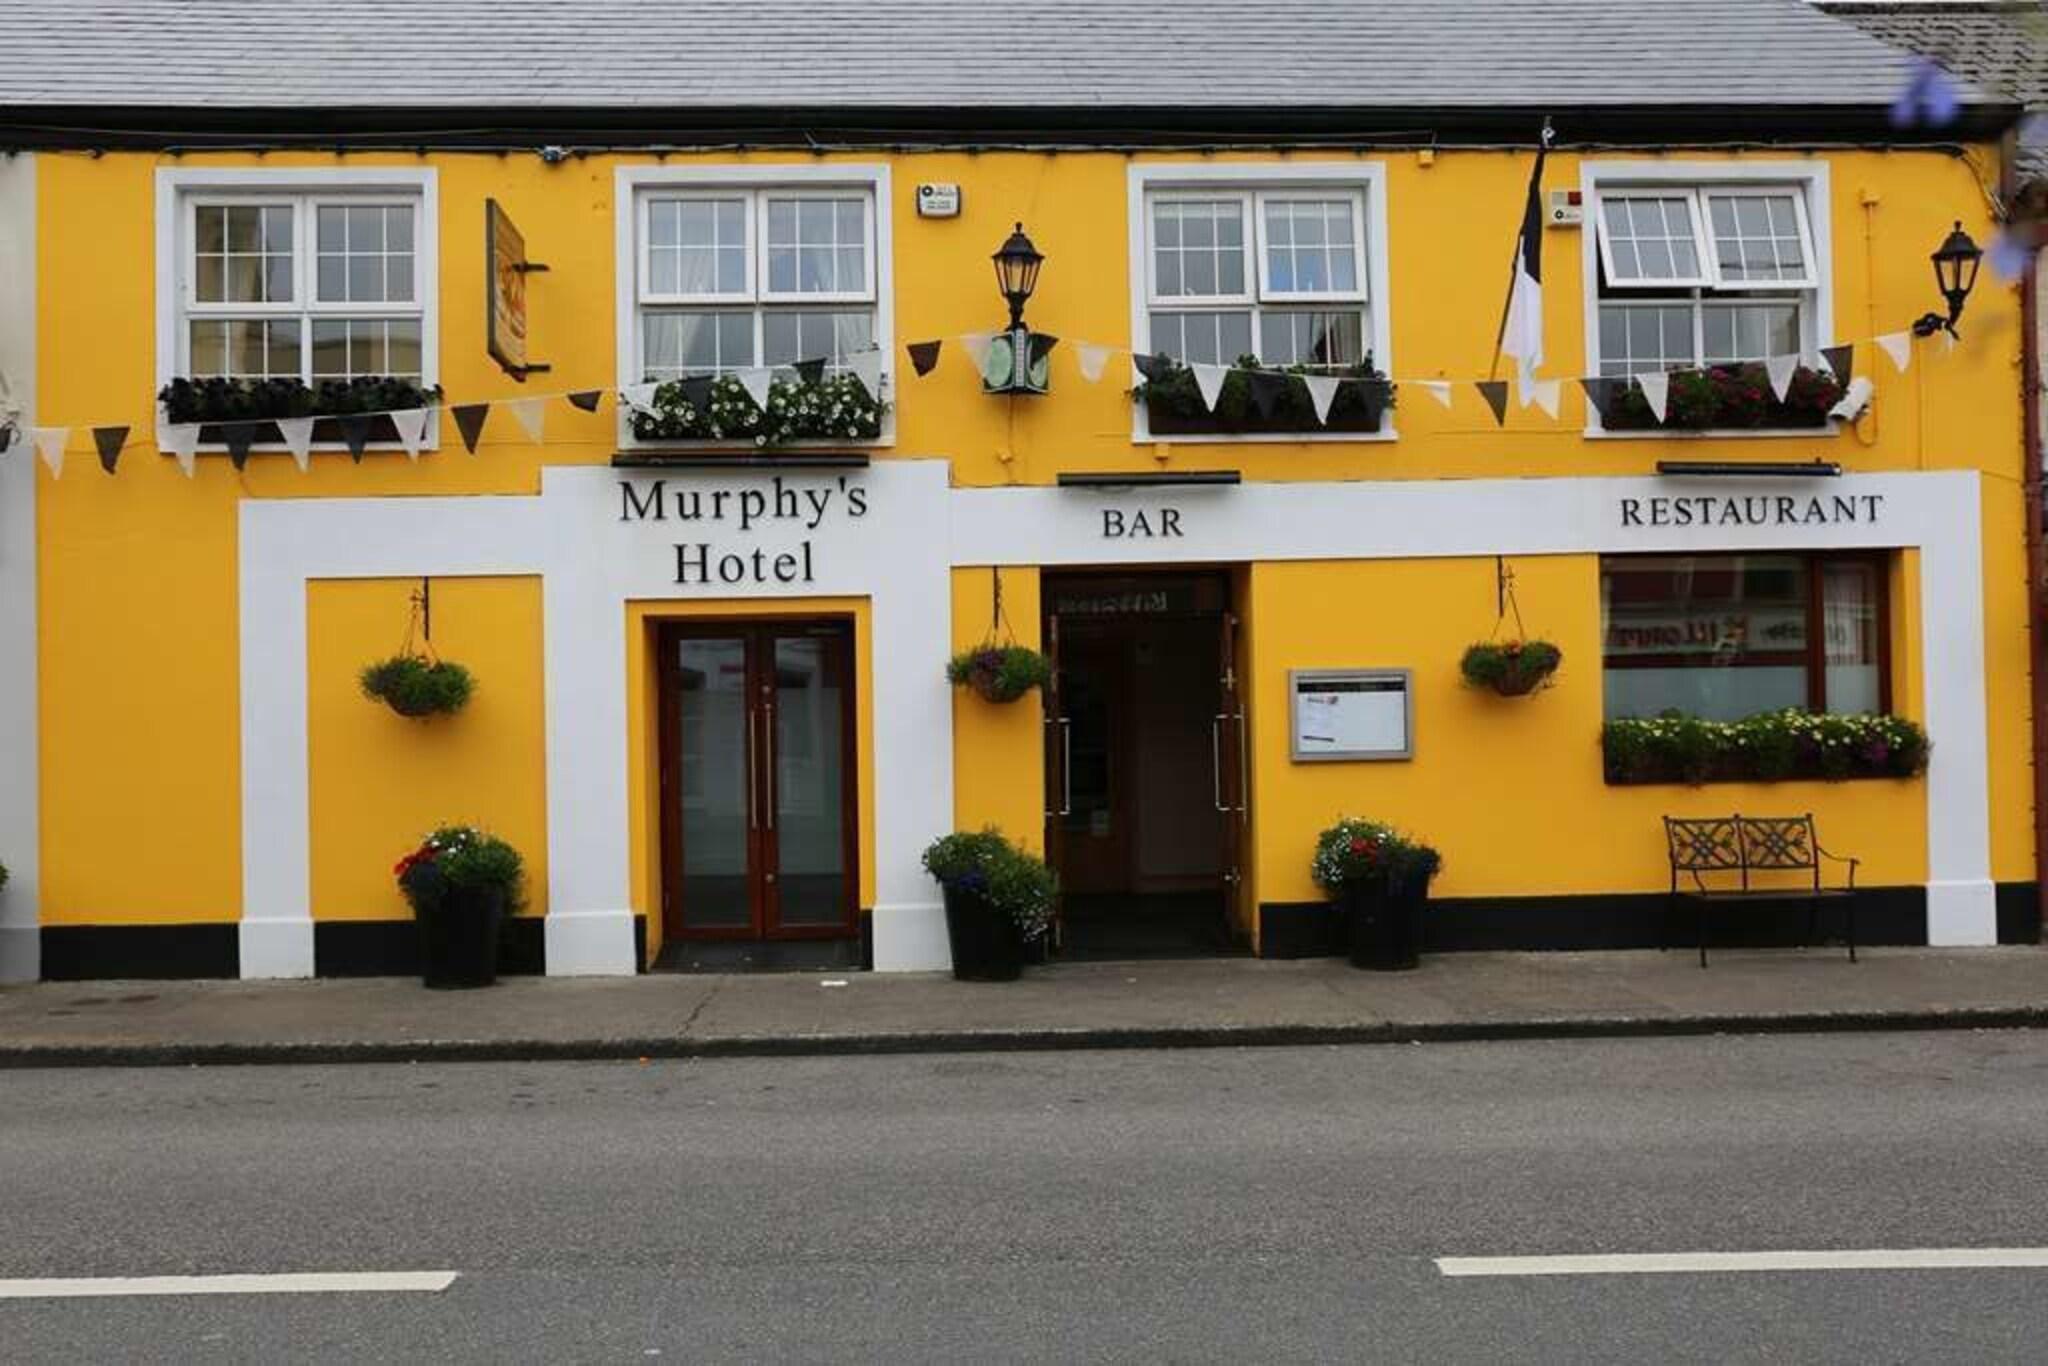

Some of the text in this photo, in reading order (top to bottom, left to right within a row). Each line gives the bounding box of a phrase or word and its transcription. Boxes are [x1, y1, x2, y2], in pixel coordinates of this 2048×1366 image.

[620, 477, 868, 530] Murphy's
[1621, 494, 1884, 527] RESTAURANT
[1103, 508, 1184, 538] BAR
[674, 541, 814, 584] Hotel
